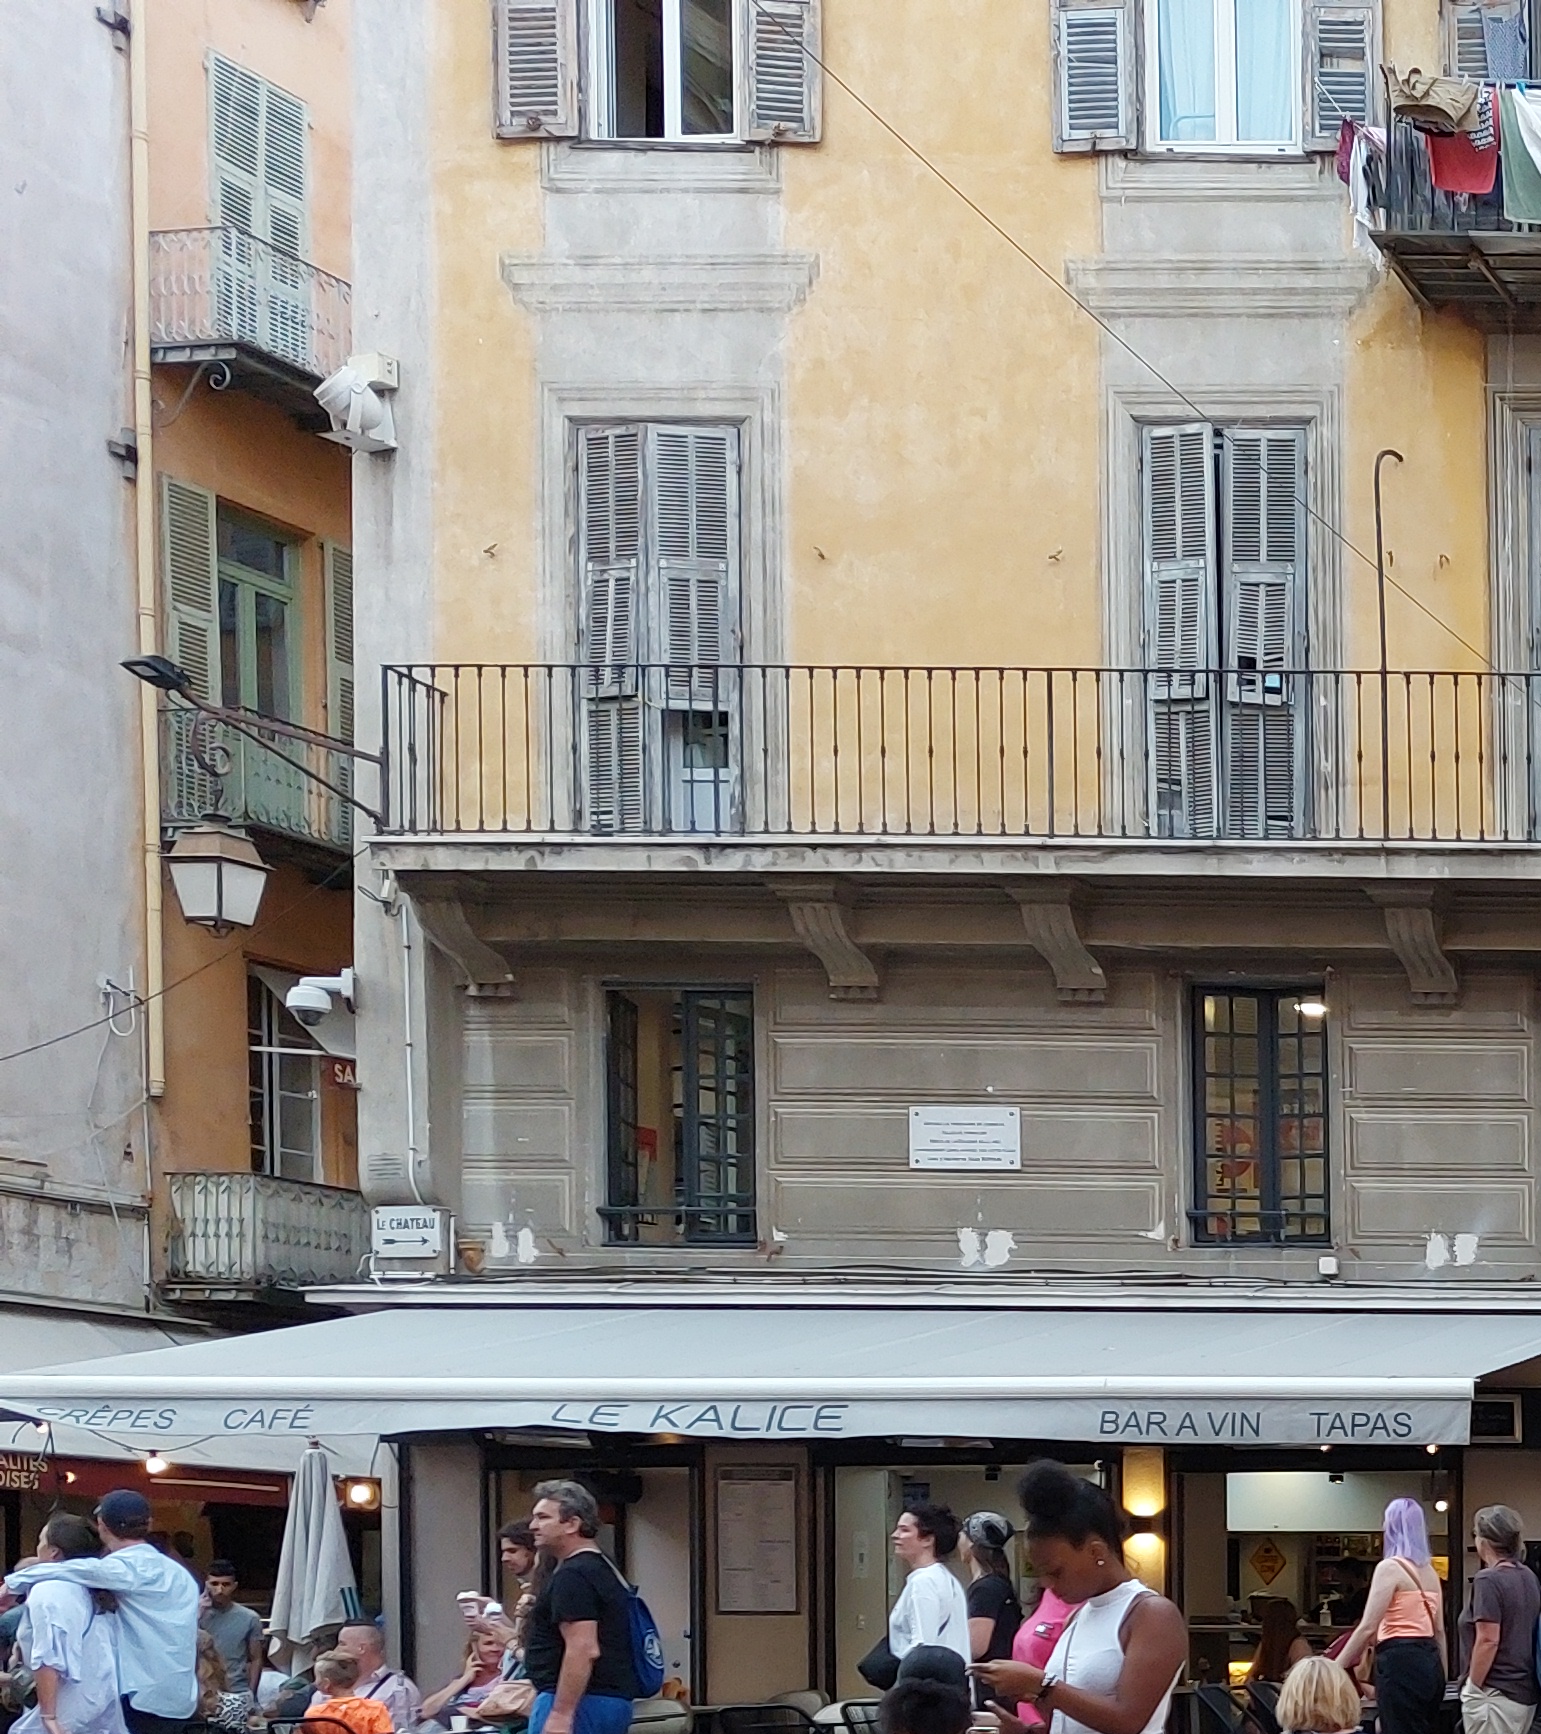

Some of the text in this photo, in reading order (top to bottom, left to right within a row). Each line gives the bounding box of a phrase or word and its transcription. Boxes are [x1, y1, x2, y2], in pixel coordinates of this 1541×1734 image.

[389, 1218, 435, 1230] CHATEAU
[36, 1404, 314, 1430] CRÊPES CAFÉ
[551, 1403, 849, 1432] LE KALICE
[1099, 1411, 1413, 1438] BAR A VIN TAPAS
